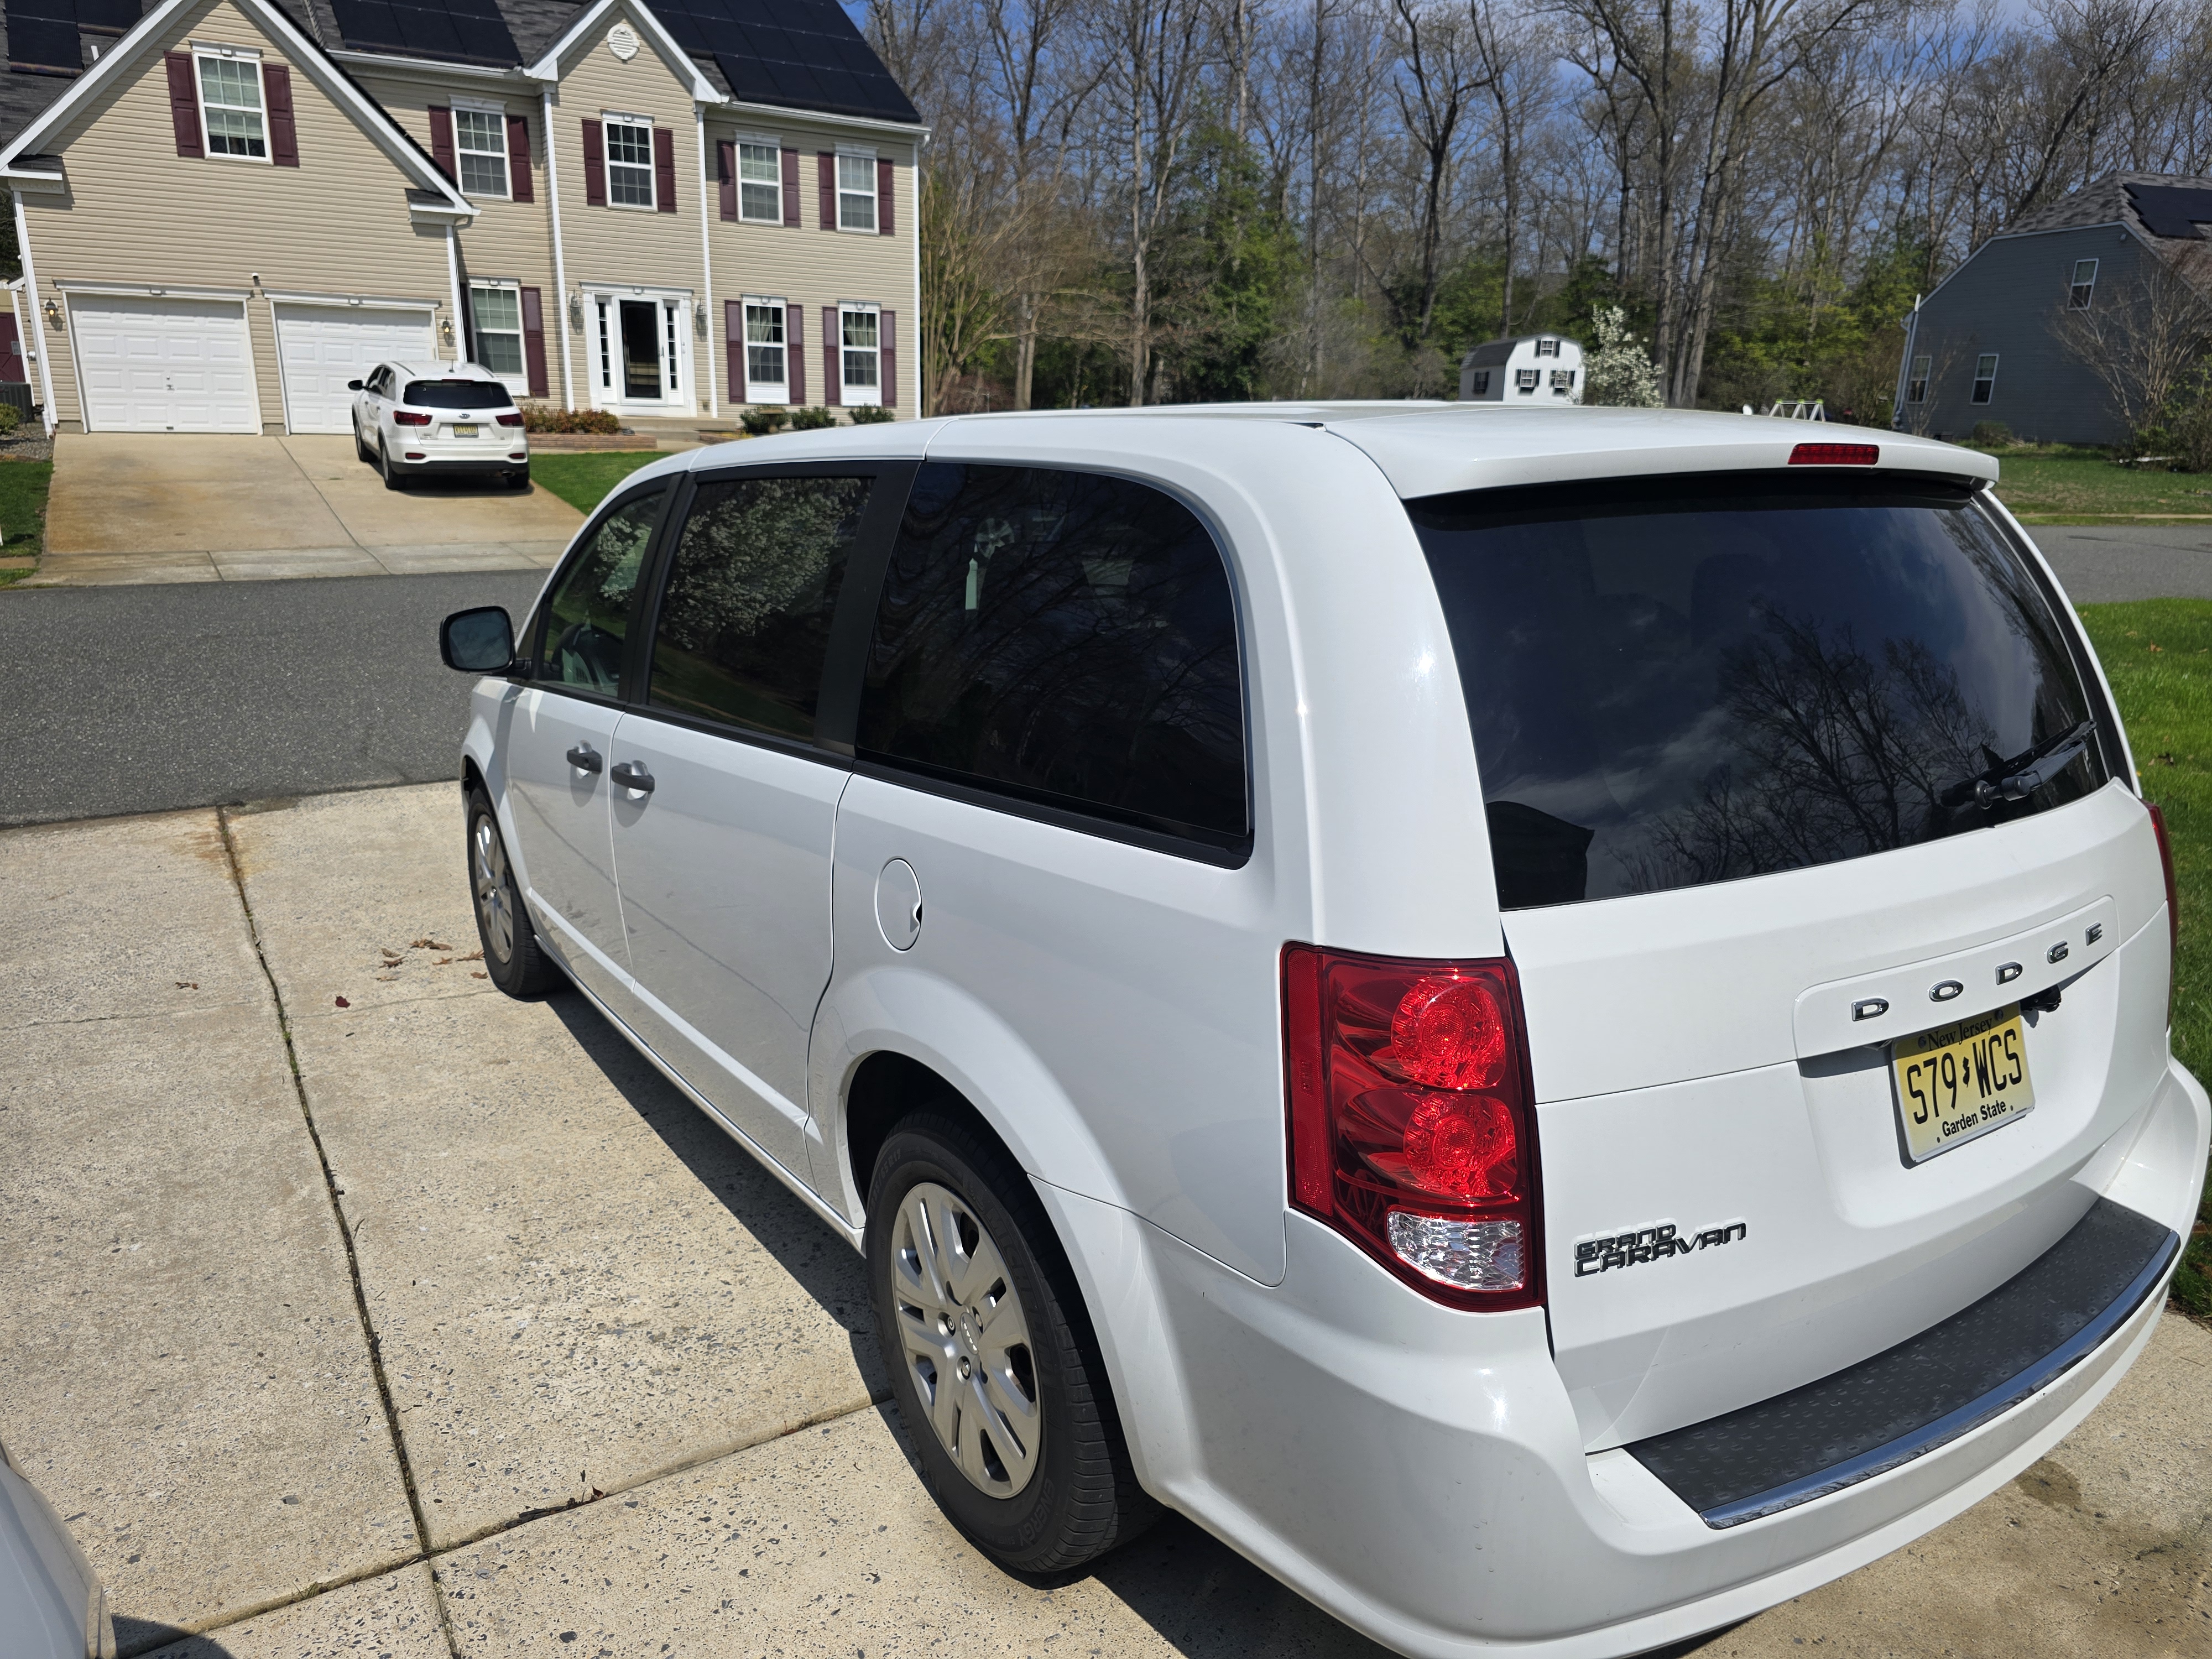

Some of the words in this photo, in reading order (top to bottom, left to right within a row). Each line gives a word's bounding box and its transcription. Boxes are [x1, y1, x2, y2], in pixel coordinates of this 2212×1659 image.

[1851, 922, 2103, 1022] DODGE
[1927, 1030, 1957, 1051] New
[1958, 1017, 1993, 1046] Jersey
[1942, 1112, 1979, 1137] Garden
[1980, 1099, 2007, 1121] State
[1573, 1223, 1677, 1260] GRAND
[1574, 1222, 1747, 1278] CARAVAN
[987, 1207, 1055, 1373] MICHELIN
[1017, 1477, 1055, 1547] ENERGY
